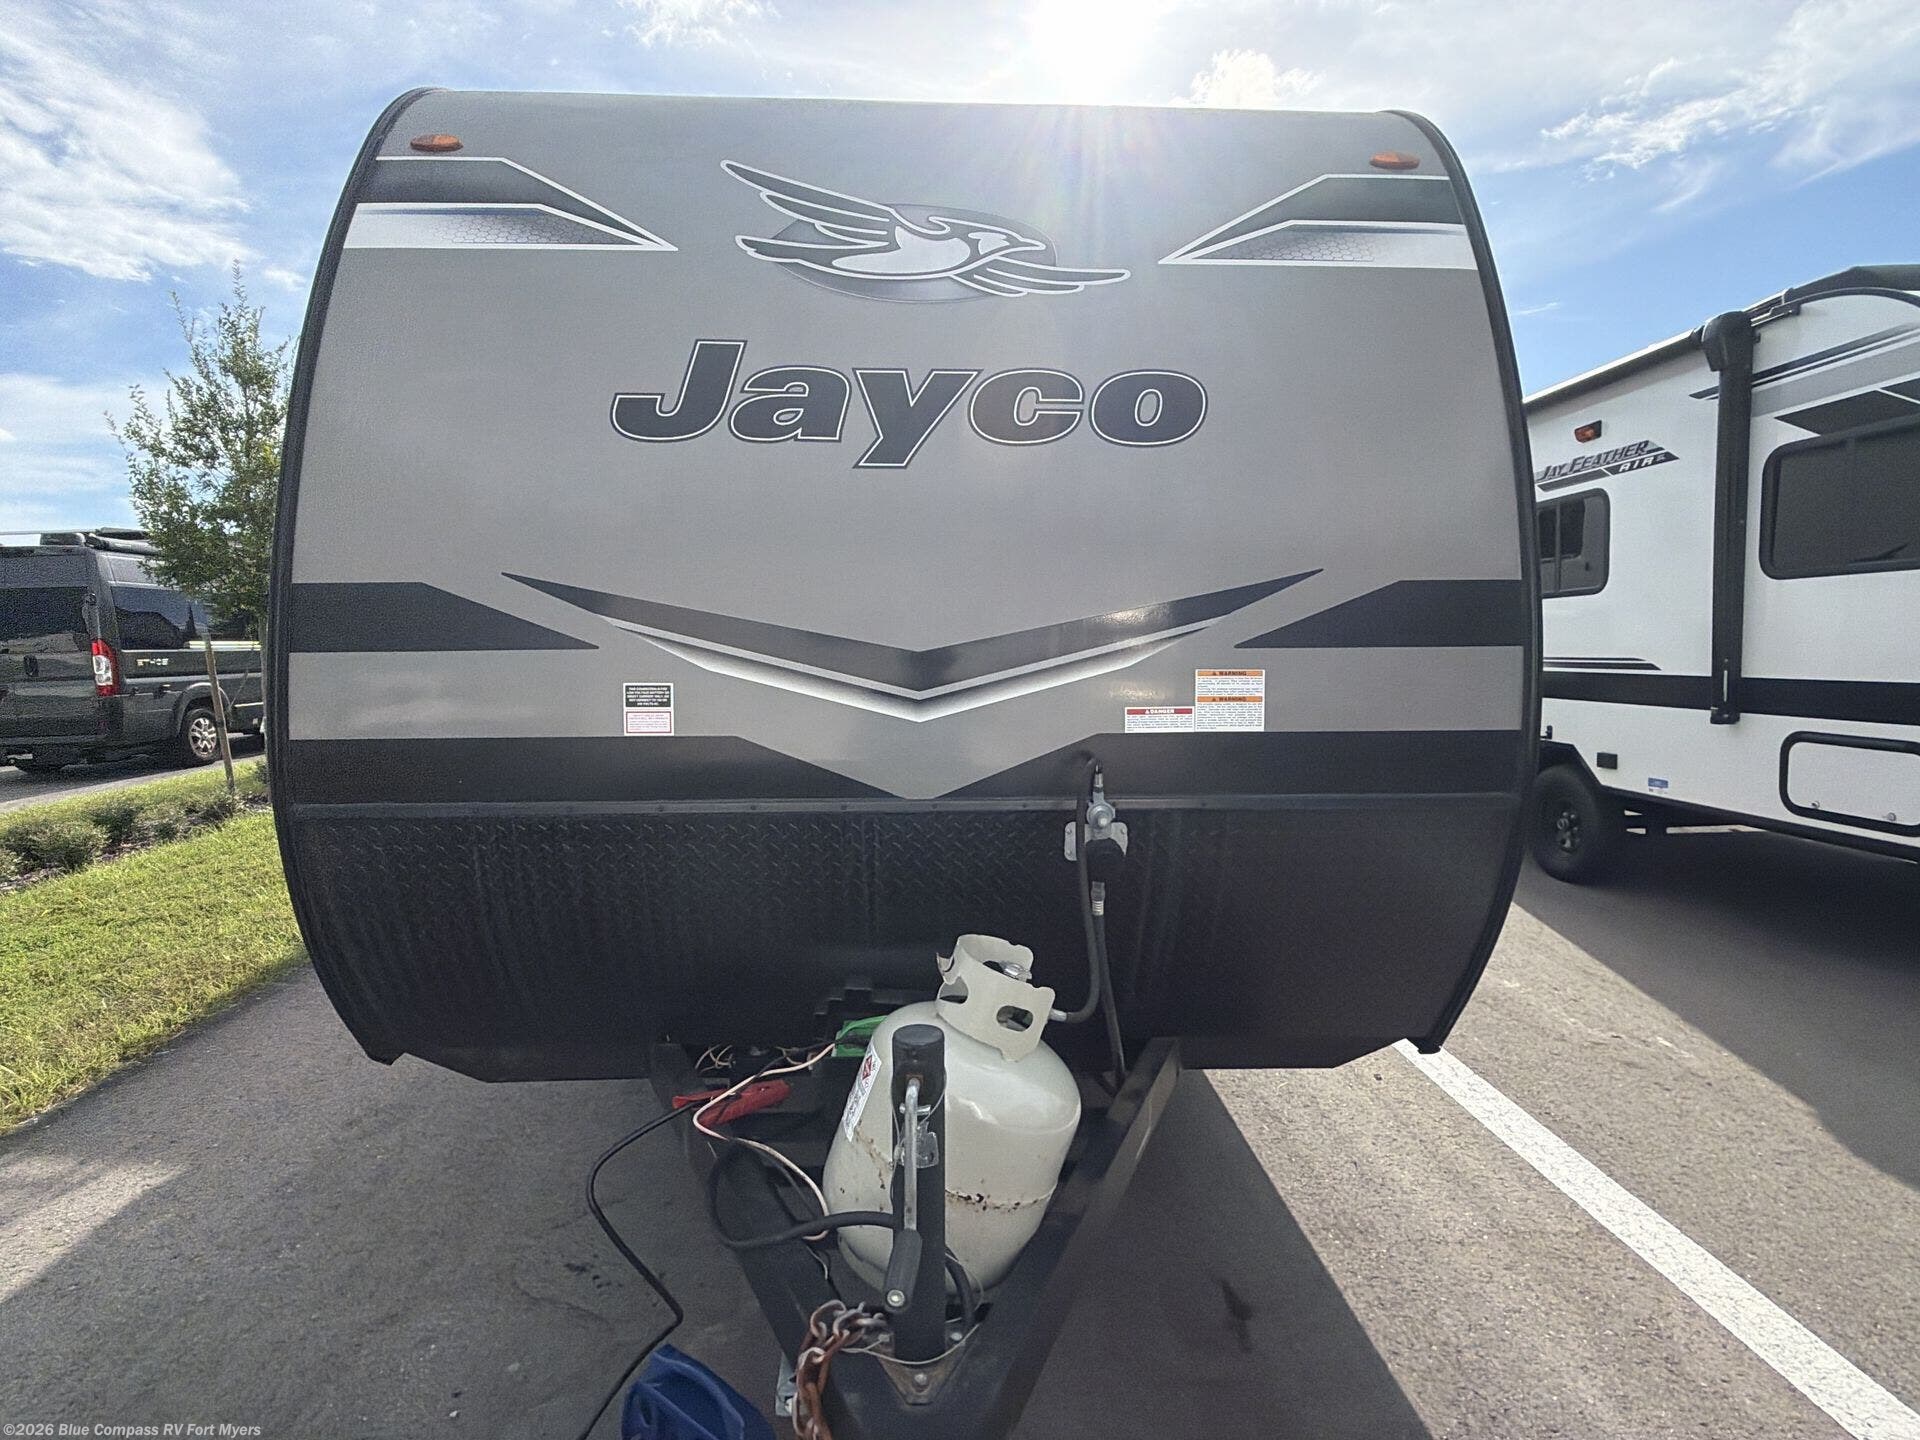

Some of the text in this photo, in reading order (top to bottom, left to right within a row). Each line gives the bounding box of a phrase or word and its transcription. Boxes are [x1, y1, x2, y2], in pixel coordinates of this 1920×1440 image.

[610, 339, 1208, 469] Jayco
[1537, 440, 1650, 481] JAY FEATHER
